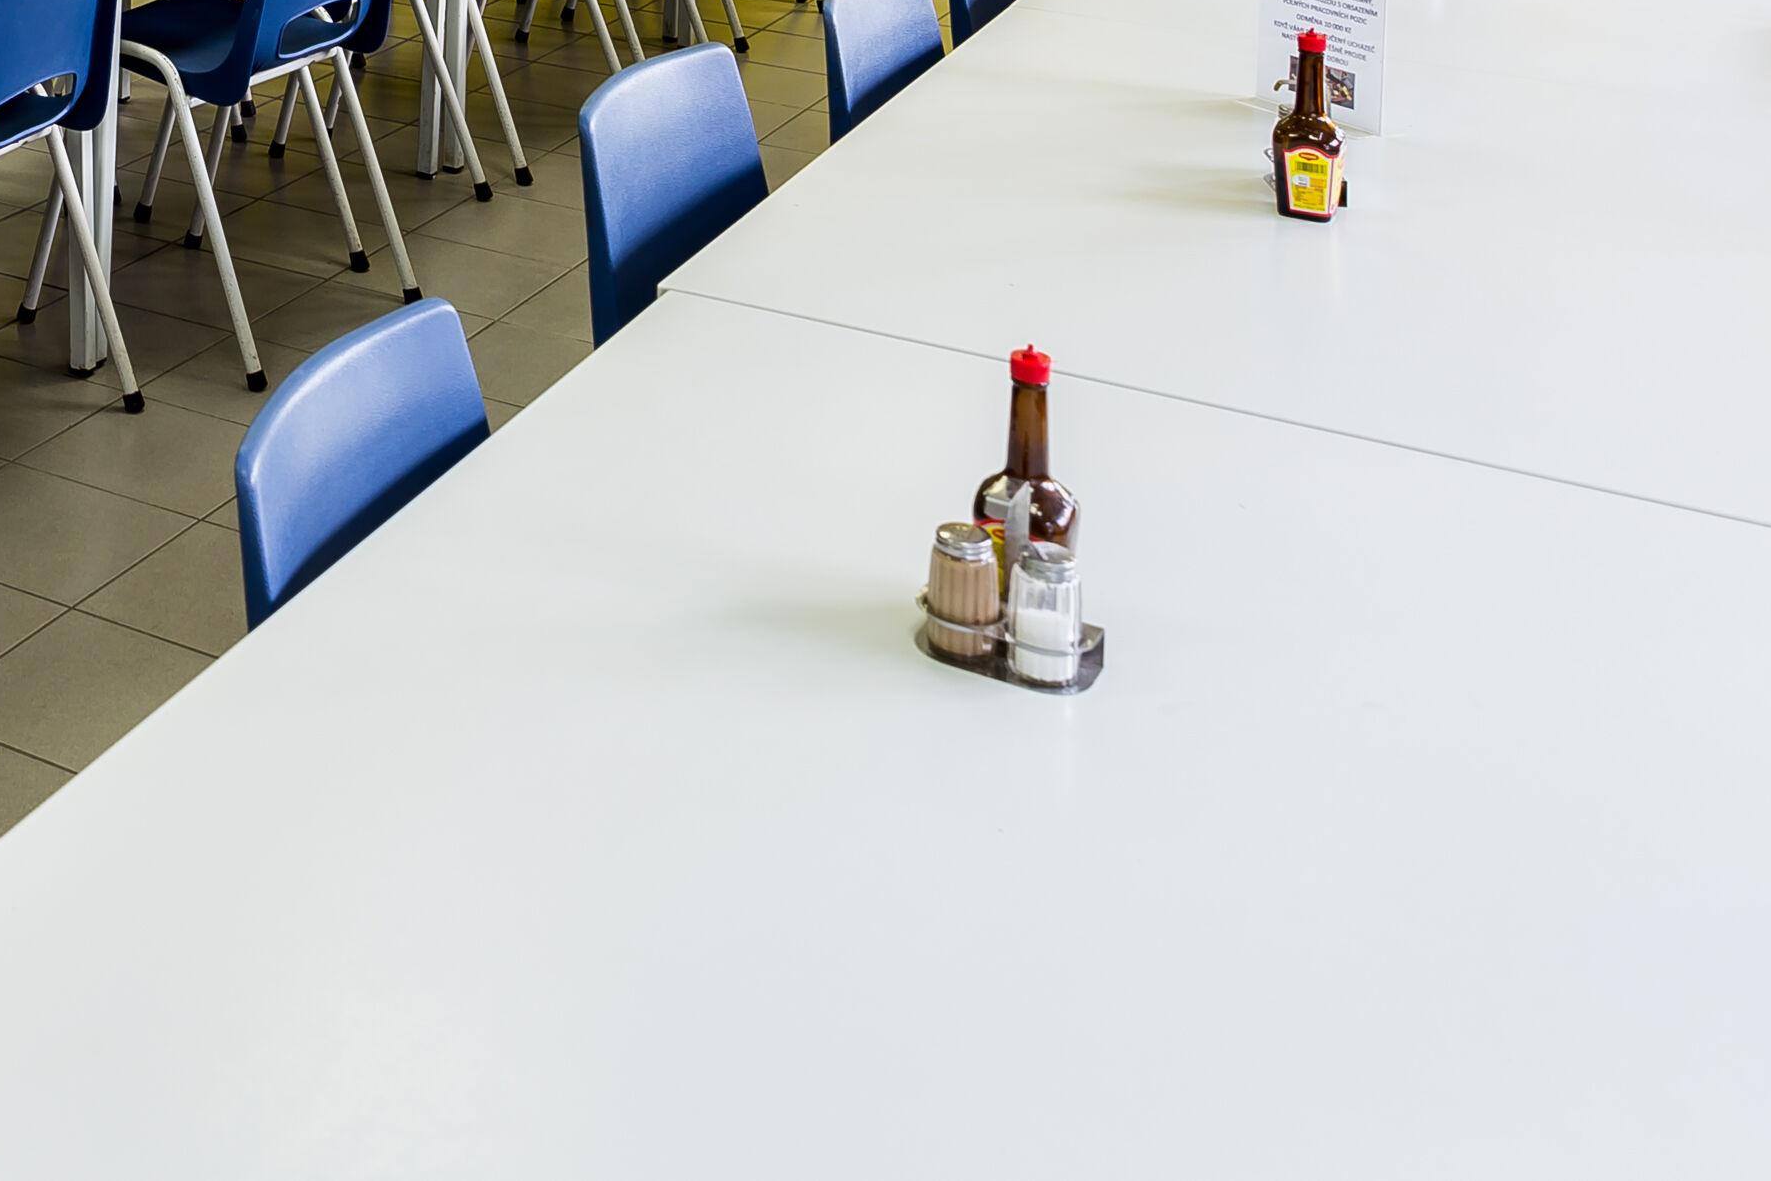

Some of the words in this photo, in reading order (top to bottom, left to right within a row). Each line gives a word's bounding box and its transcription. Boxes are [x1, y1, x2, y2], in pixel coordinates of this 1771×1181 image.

[1296, 13, 1323, 25] ODMĚNA
[1311, 4, 1349, 19] PRACOVNÍCH
[1350, 14, 1368, 25] POZIC
